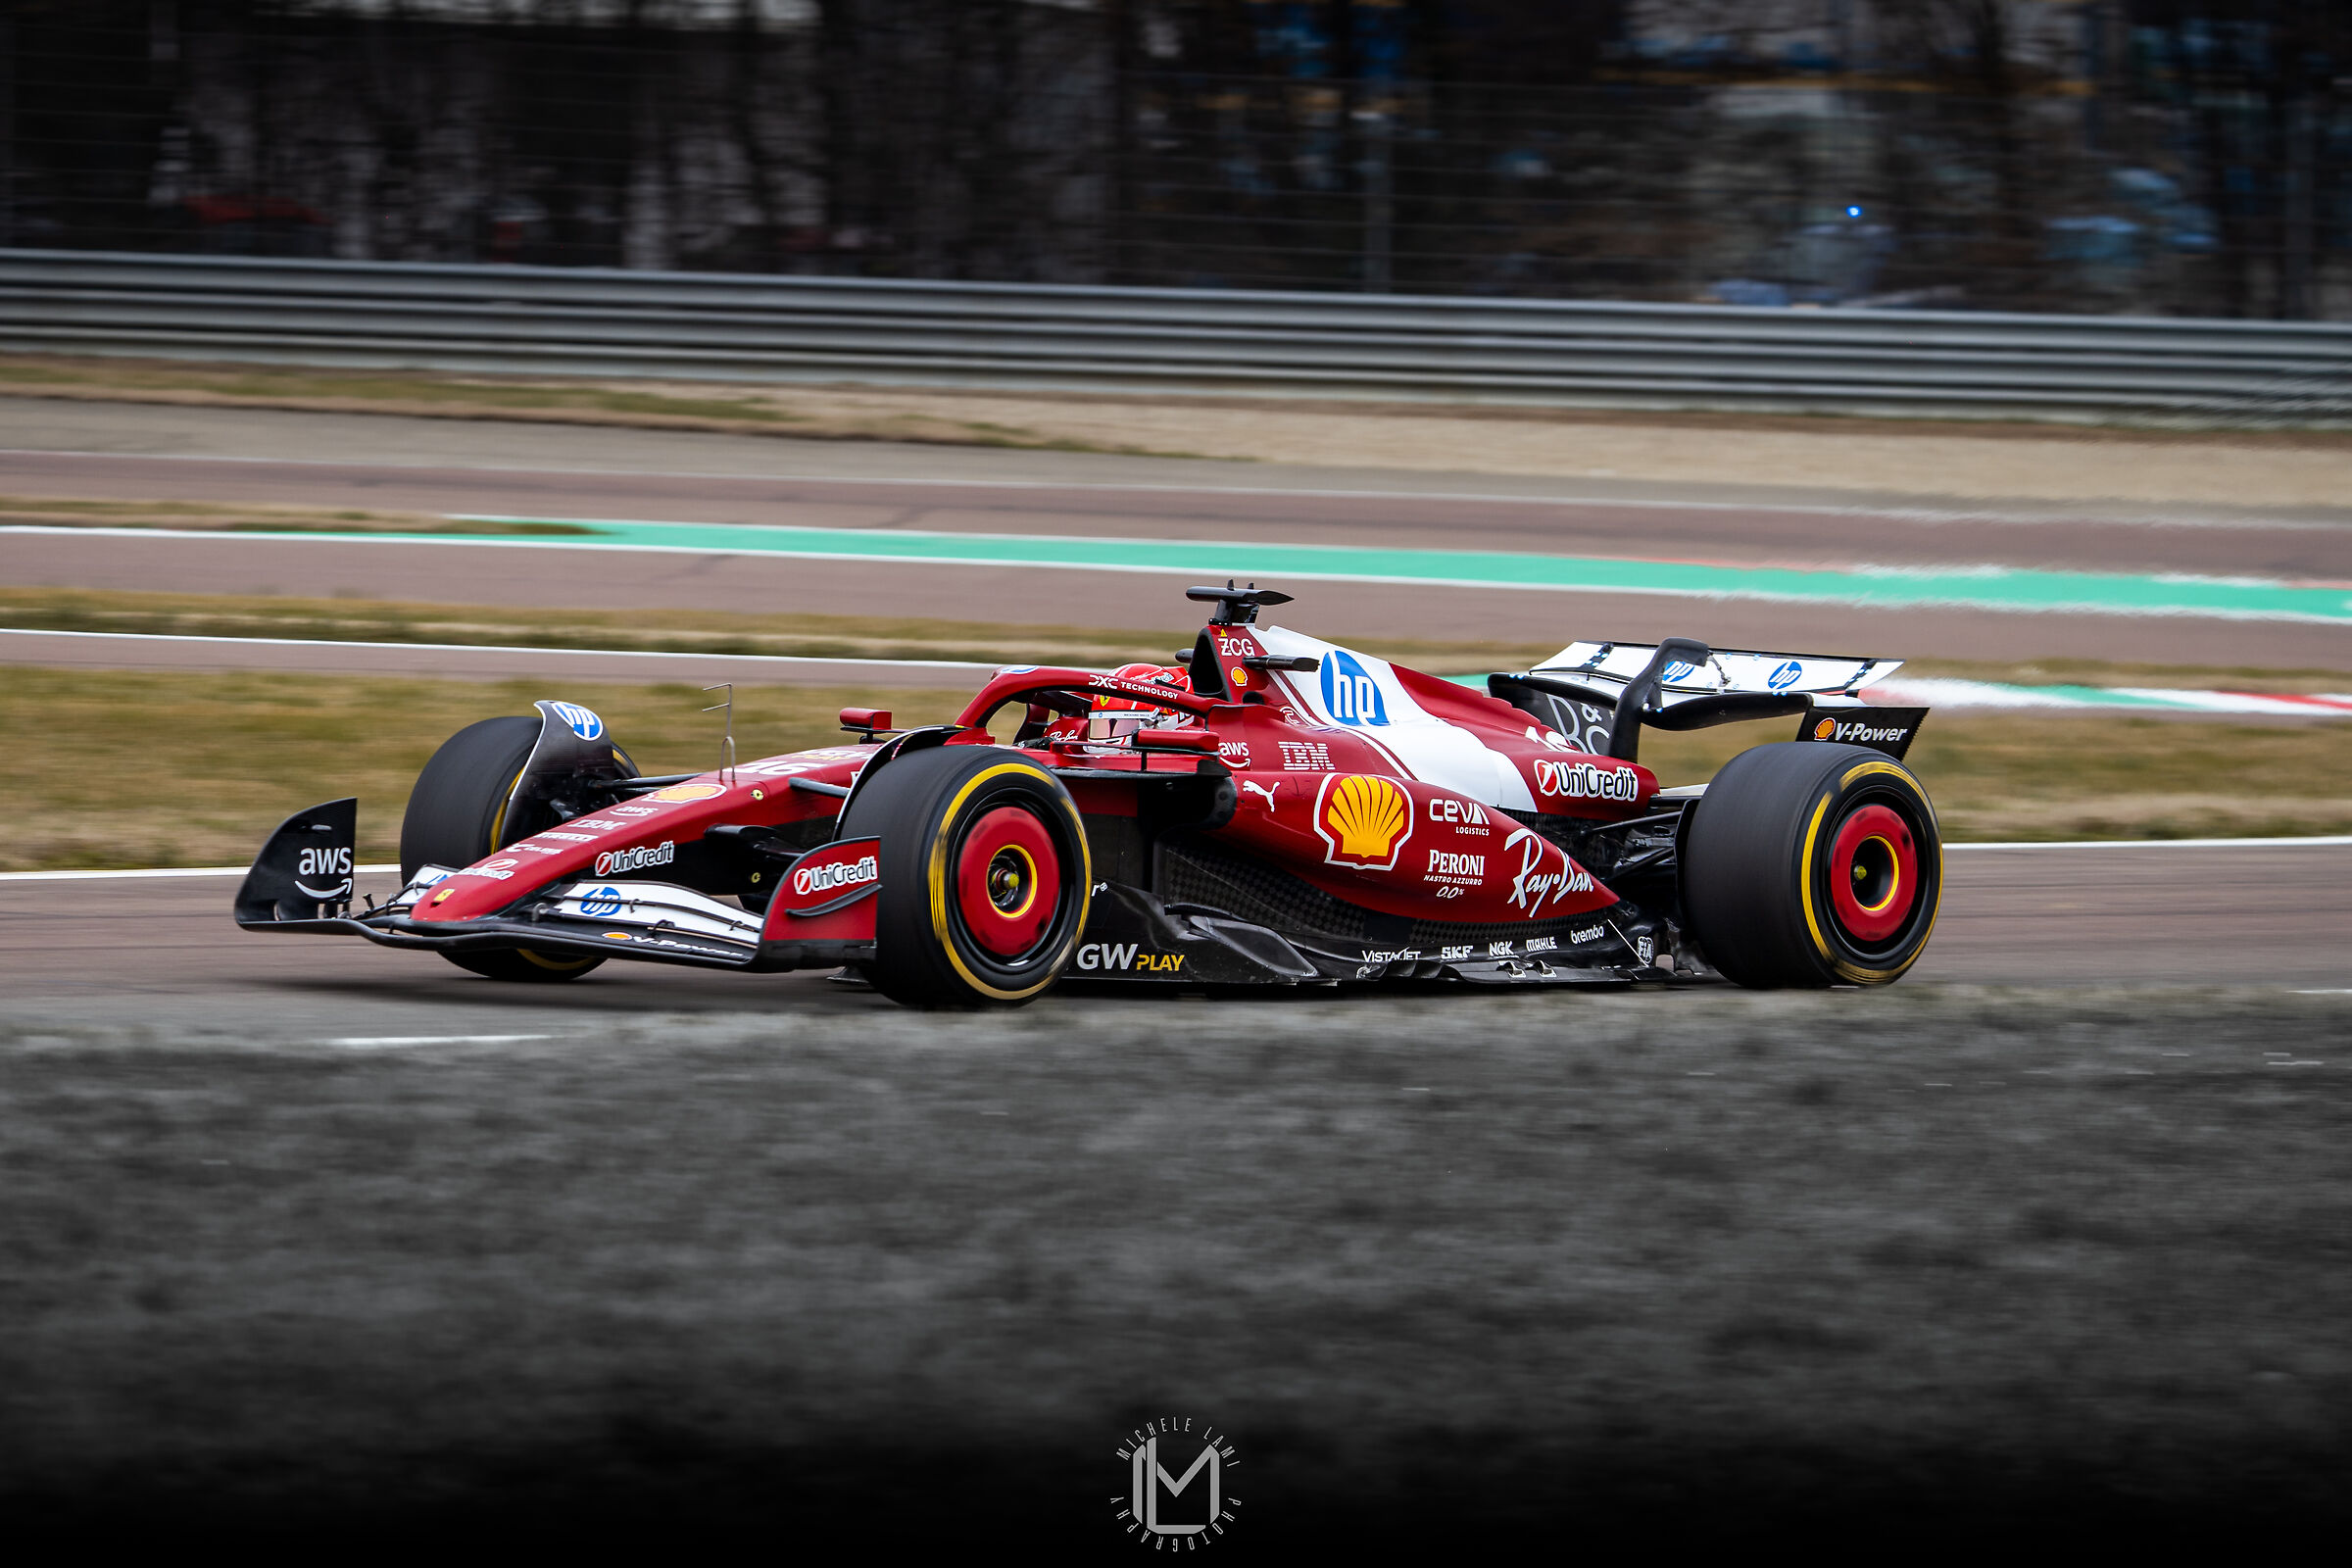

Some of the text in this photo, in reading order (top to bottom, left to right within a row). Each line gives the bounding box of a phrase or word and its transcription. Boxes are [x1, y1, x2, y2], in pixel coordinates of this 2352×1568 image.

[1089, 674, 1178, 700] DXC TECHNOLOGY
[1325, 651, 1385, 725] hp
[1768, 662, 1801, 689] hp
[554, 703, 601, 739] hp
[1836, 722, 1908, 742] V-Power
[1217, 742, 1250, 757] aws
[1278, 741, 1336, 770] IBM
[1556, 761, 1638, 802] UniCredit
[1455, 826, 1490, 836] LOGISTICS
[299, 847, 352, 876] aws
[612, 841, 674, 872] UniCredit
[1427, 849, 1485, 876] PERONI
[810, 857, 877, 890] UniCredit
[1424, 874, 1483, 886] NASTRO AZZURRO
[581, 887, 621, 917] hp
[1436, 885, 1465, 899] 0.0%
[1526, 936, 1557, 952] MAHLE
[1570, 924, 1604, 945] brembo
[1441, 946, 1473, 959] SKF
[1489, 940, 1514, 956] NGK
[1136, 955, 1185, 971] PLAY
